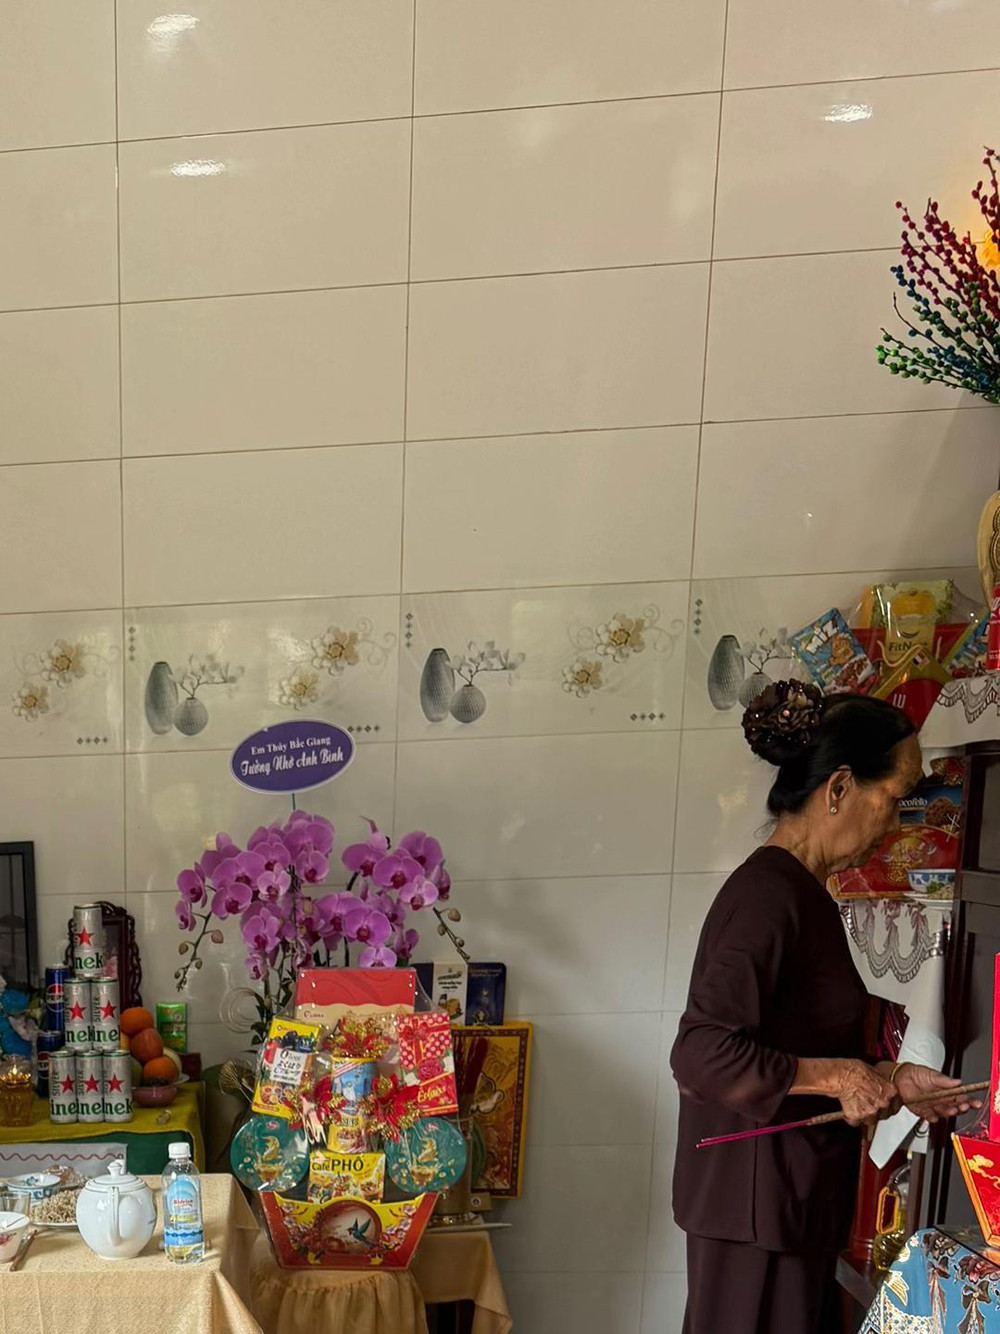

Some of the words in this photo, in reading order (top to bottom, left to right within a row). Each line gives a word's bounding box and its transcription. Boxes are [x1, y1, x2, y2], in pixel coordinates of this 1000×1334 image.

[251, 746, 265, 755] Em
[289, 738, 304, 749] Bắc
[306, 736, 331, 747] Giang
[296, 750, 317, 768] Anh
[320, 747, 343, 765] Bình
